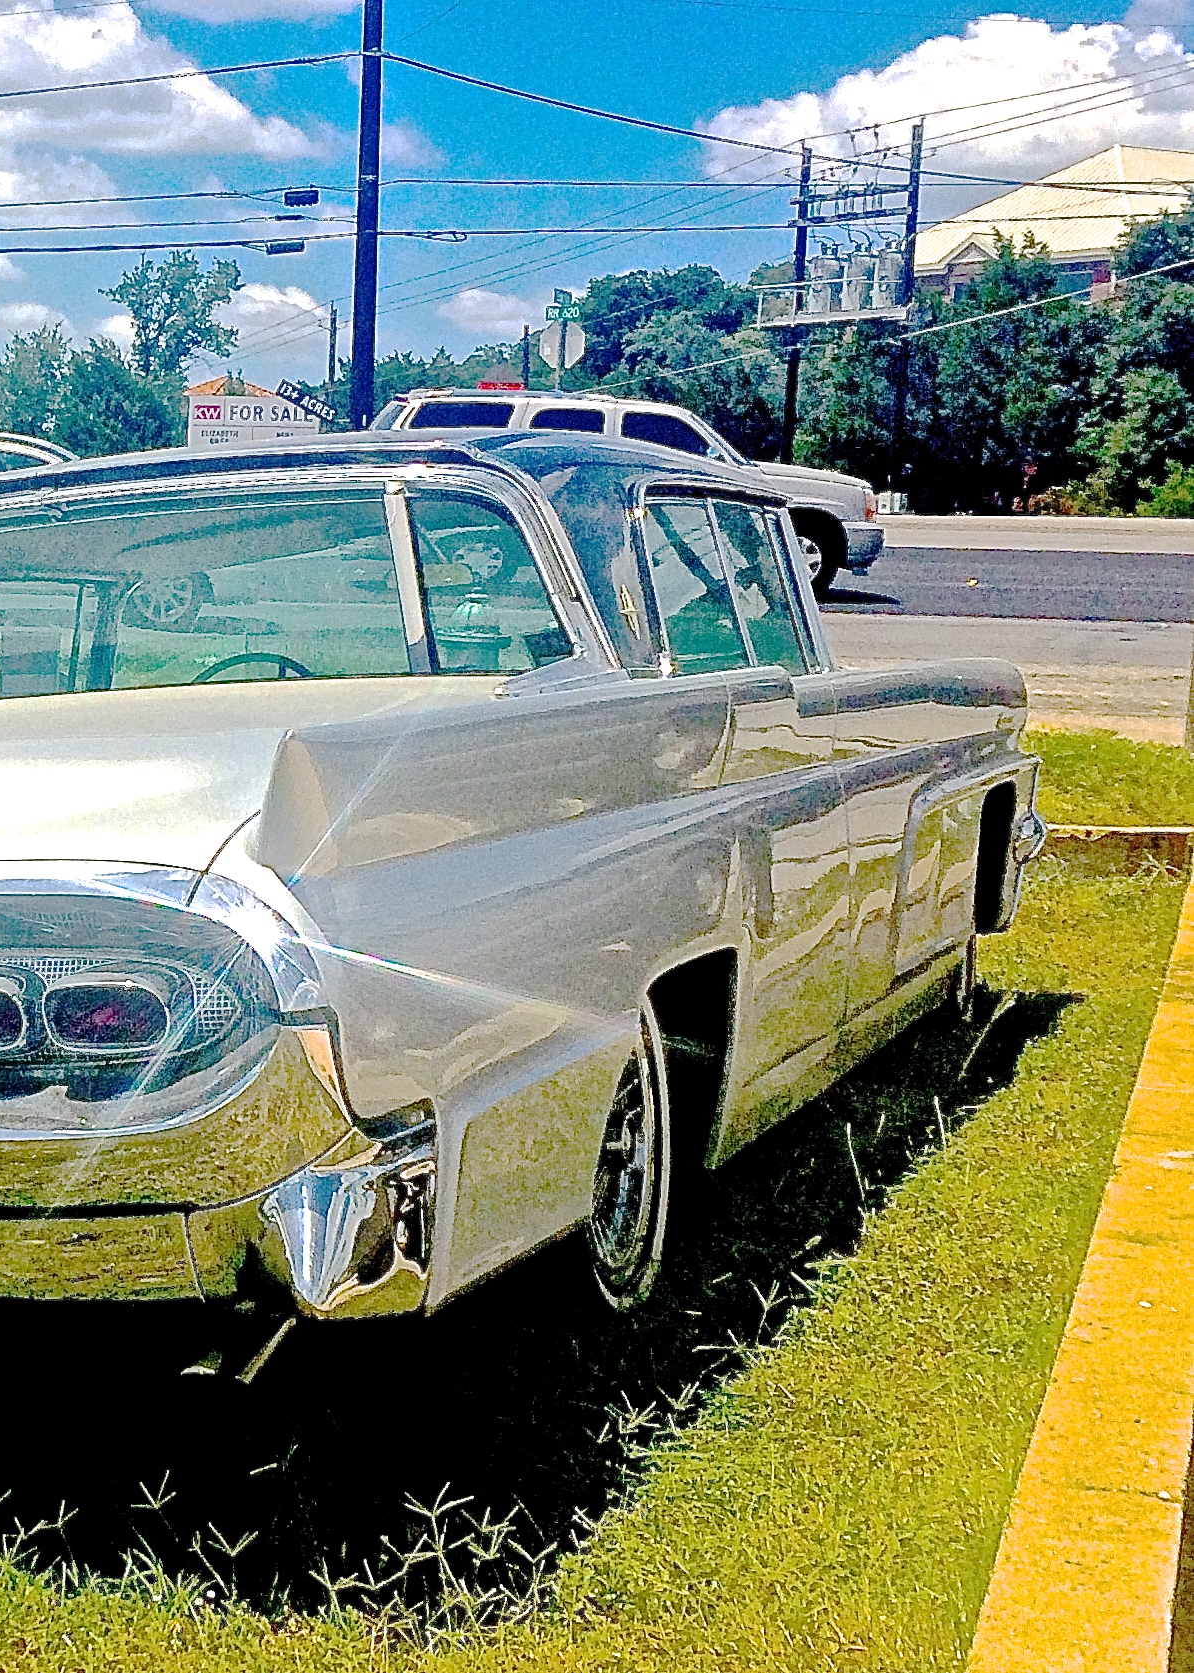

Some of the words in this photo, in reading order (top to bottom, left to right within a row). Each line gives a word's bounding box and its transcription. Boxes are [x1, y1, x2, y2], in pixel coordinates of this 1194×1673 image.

[547, 308, 560, 319] RR
[562, 306, 580, 318] 620
[194, 406, 221, 420] KW
[229, 404, 264, 422] FOR
[300, 395, 336, 420] ACRES
